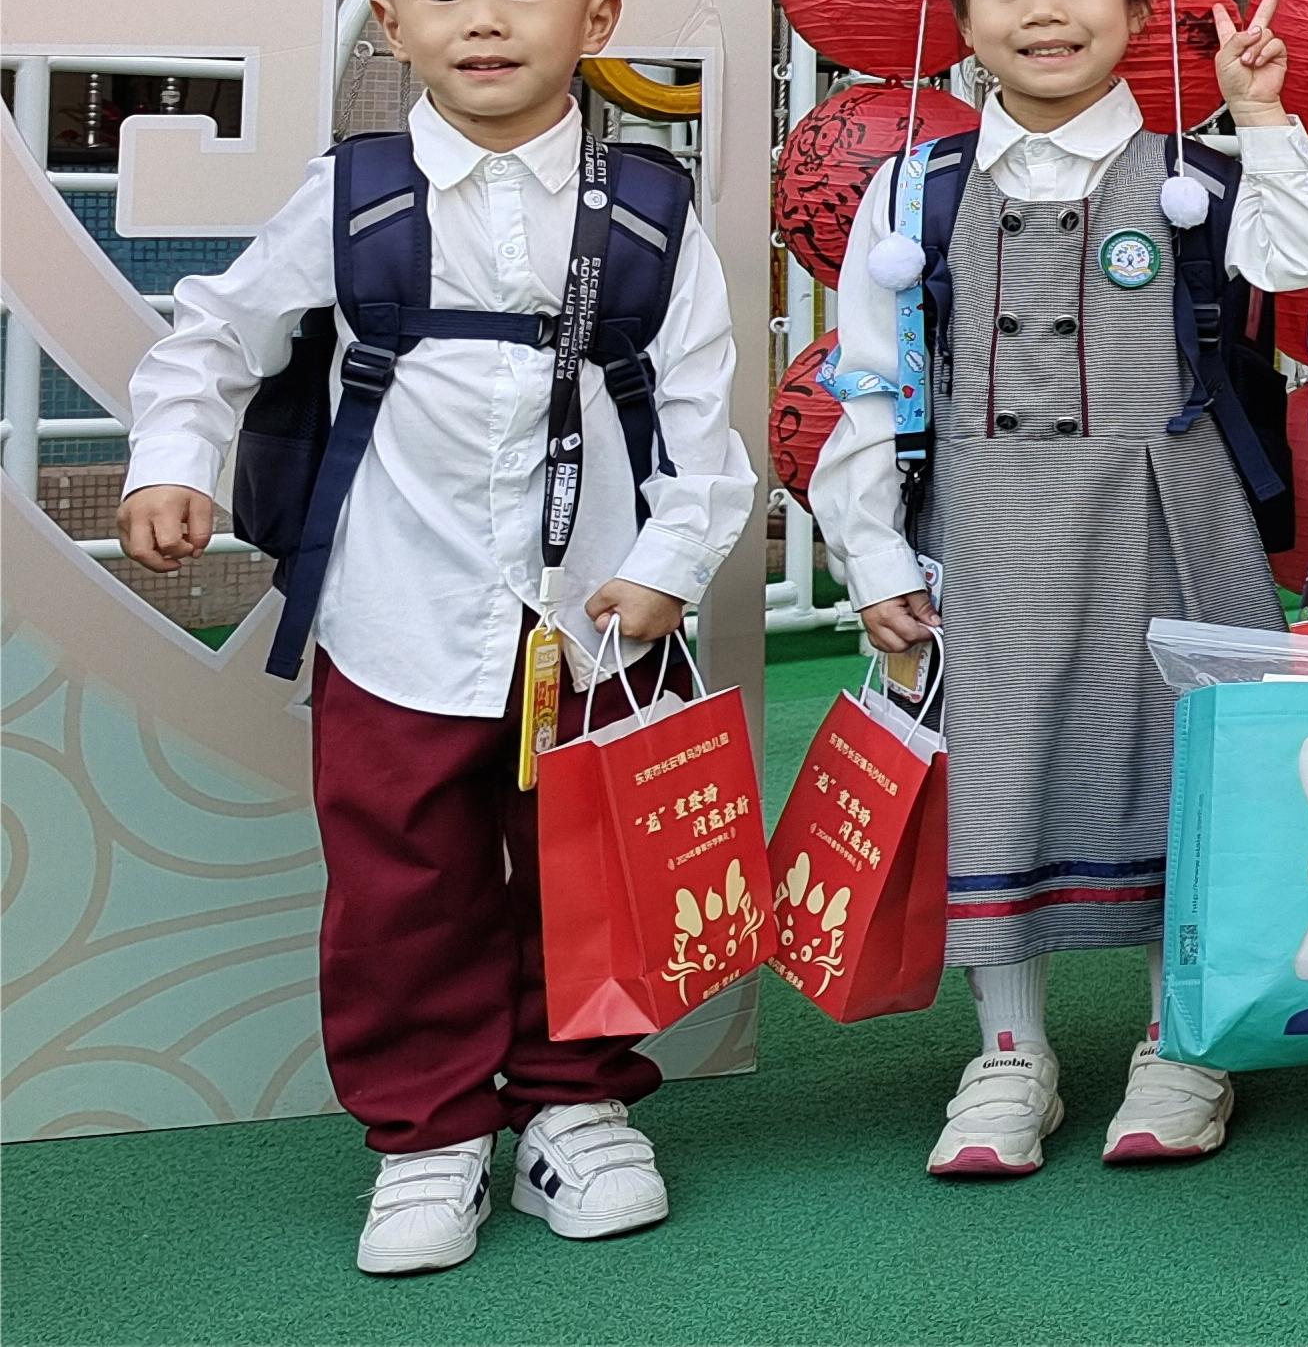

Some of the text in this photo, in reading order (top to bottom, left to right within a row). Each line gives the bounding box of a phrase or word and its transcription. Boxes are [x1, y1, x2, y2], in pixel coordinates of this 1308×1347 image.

[556, 284, 578, 380] EXCELLENT
[565, 466, 578, 495] ALL
[983, 1058, 1033, 1069] Ginoble
